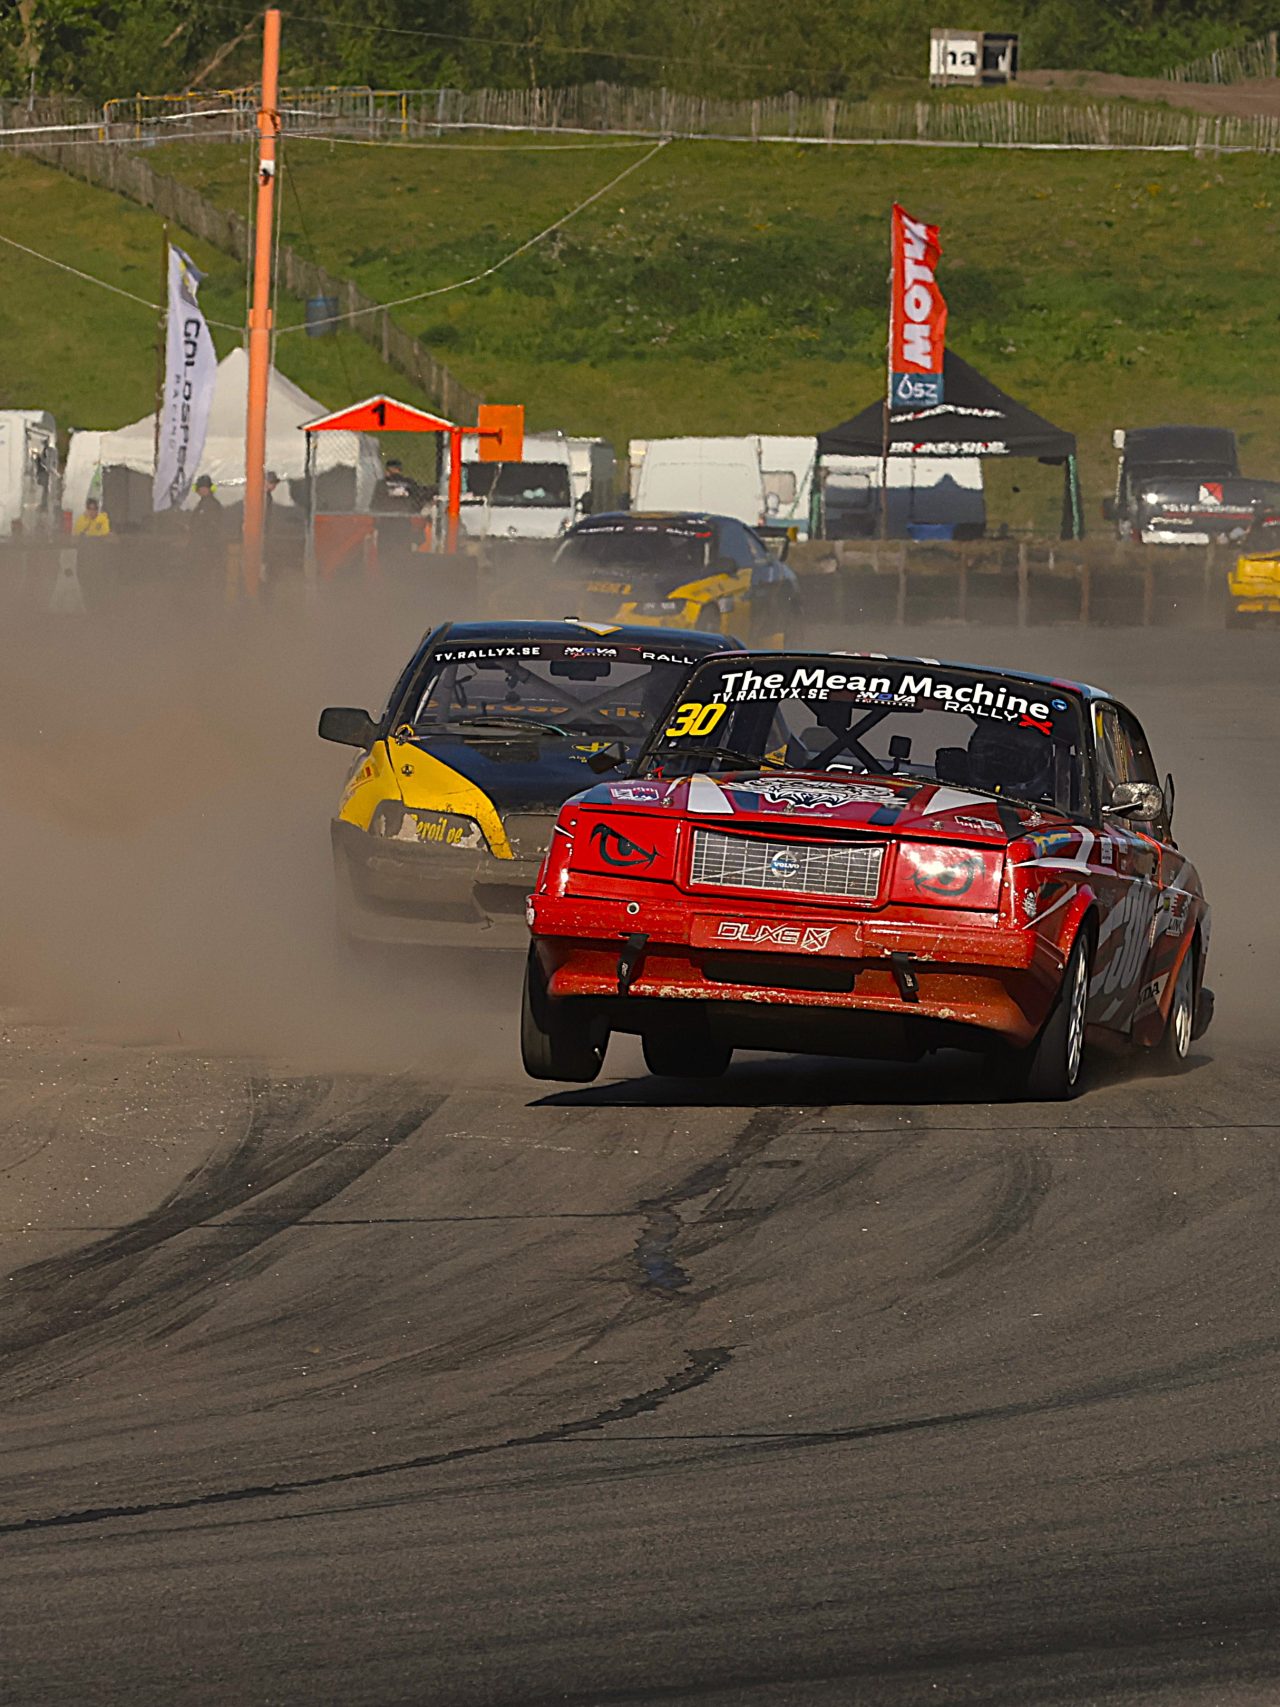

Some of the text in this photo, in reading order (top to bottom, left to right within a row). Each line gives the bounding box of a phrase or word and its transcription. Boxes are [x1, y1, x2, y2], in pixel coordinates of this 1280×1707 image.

[170, 316, 202, 503] GOLDSPE
[371, 402, 386, 427] 1
[434, 646, 541, 662] TV.RALLYX.SE
[642, 650, 699, 666] RALL
[712, 687, 830, 704] TV.RALLYX.SE
[720, 668, 1050, 720] The Mean Machine
[665, 702, 728, 738] 30
[772, 860, 800, 871] VOLVO
